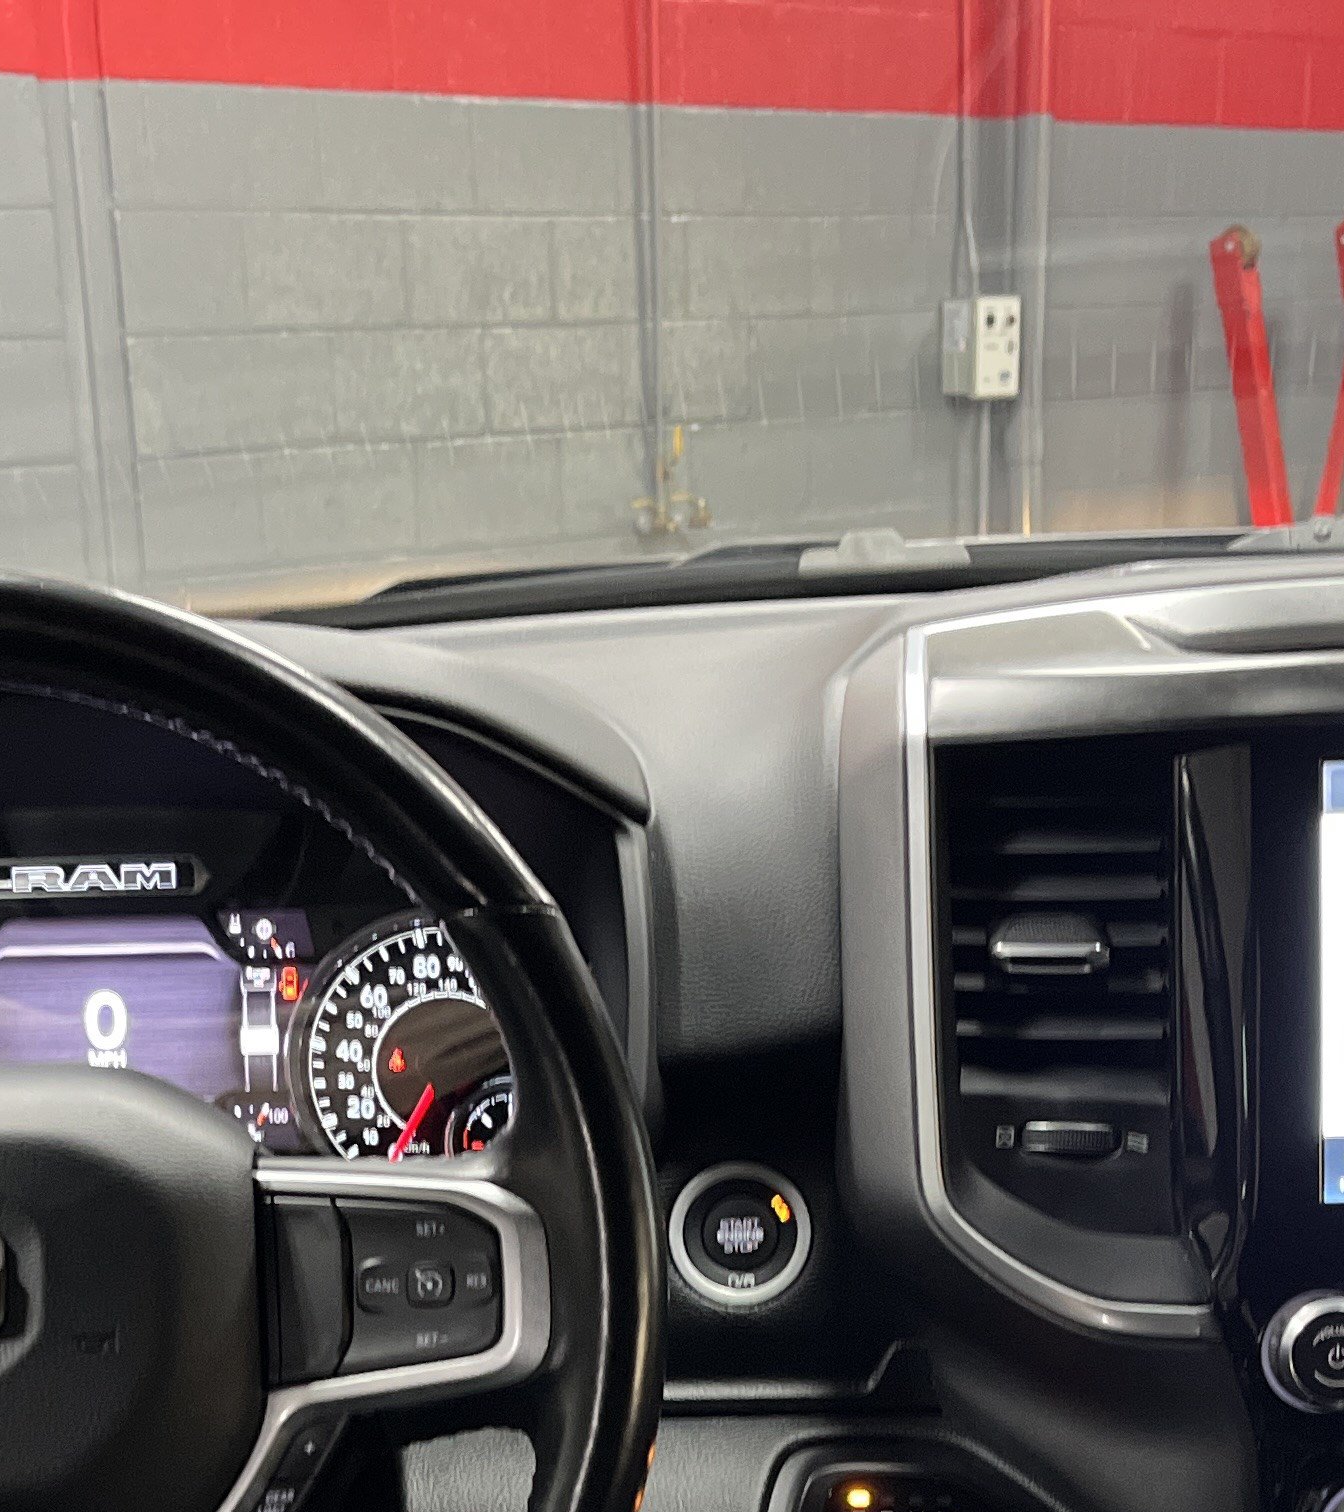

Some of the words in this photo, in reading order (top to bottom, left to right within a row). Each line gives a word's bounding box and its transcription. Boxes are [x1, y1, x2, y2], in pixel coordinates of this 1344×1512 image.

[11, 863, 176, 893] RAM
[388, 965, 406, 985] 70
[413, 953, 441, 979] 80
[360, 982, 388, 1009] 60
[83, 989, 127, 1050] 0
[346, 1010, 363, 1029] 50
[88, 1050, 127, 1068] MPH
[336, 1038, 363, 1062] 40
[346, 1095, 375, 1119] 20
[362, 1127, 380, 1146] 10
